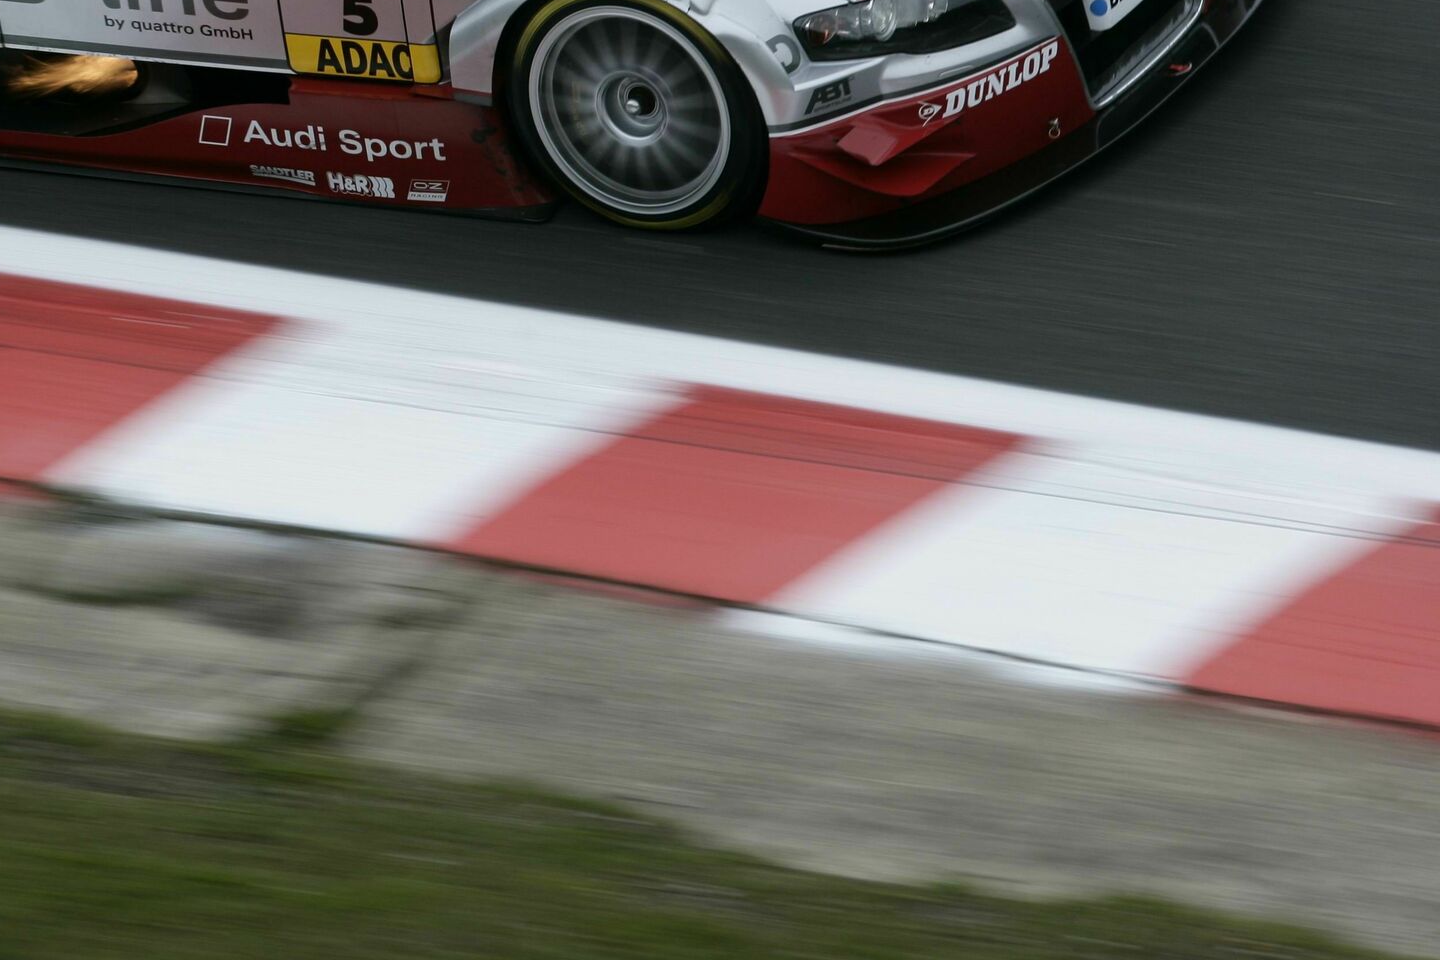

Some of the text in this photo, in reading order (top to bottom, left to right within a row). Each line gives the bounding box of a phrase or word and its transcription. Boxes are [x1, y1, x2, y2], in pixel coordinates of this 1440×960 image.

[104, 15, 253, 41] by quattro GmbH
[317, 38, 414, 80] ADAC
[804, 77, 852, 115] ABT
[942, 40, 1058, 118] DUNLOP
[244, 120, 447, 162] Audi Sport
[326, 171, 370, 195] H&R
[413, 181, 443, 190] OZ
